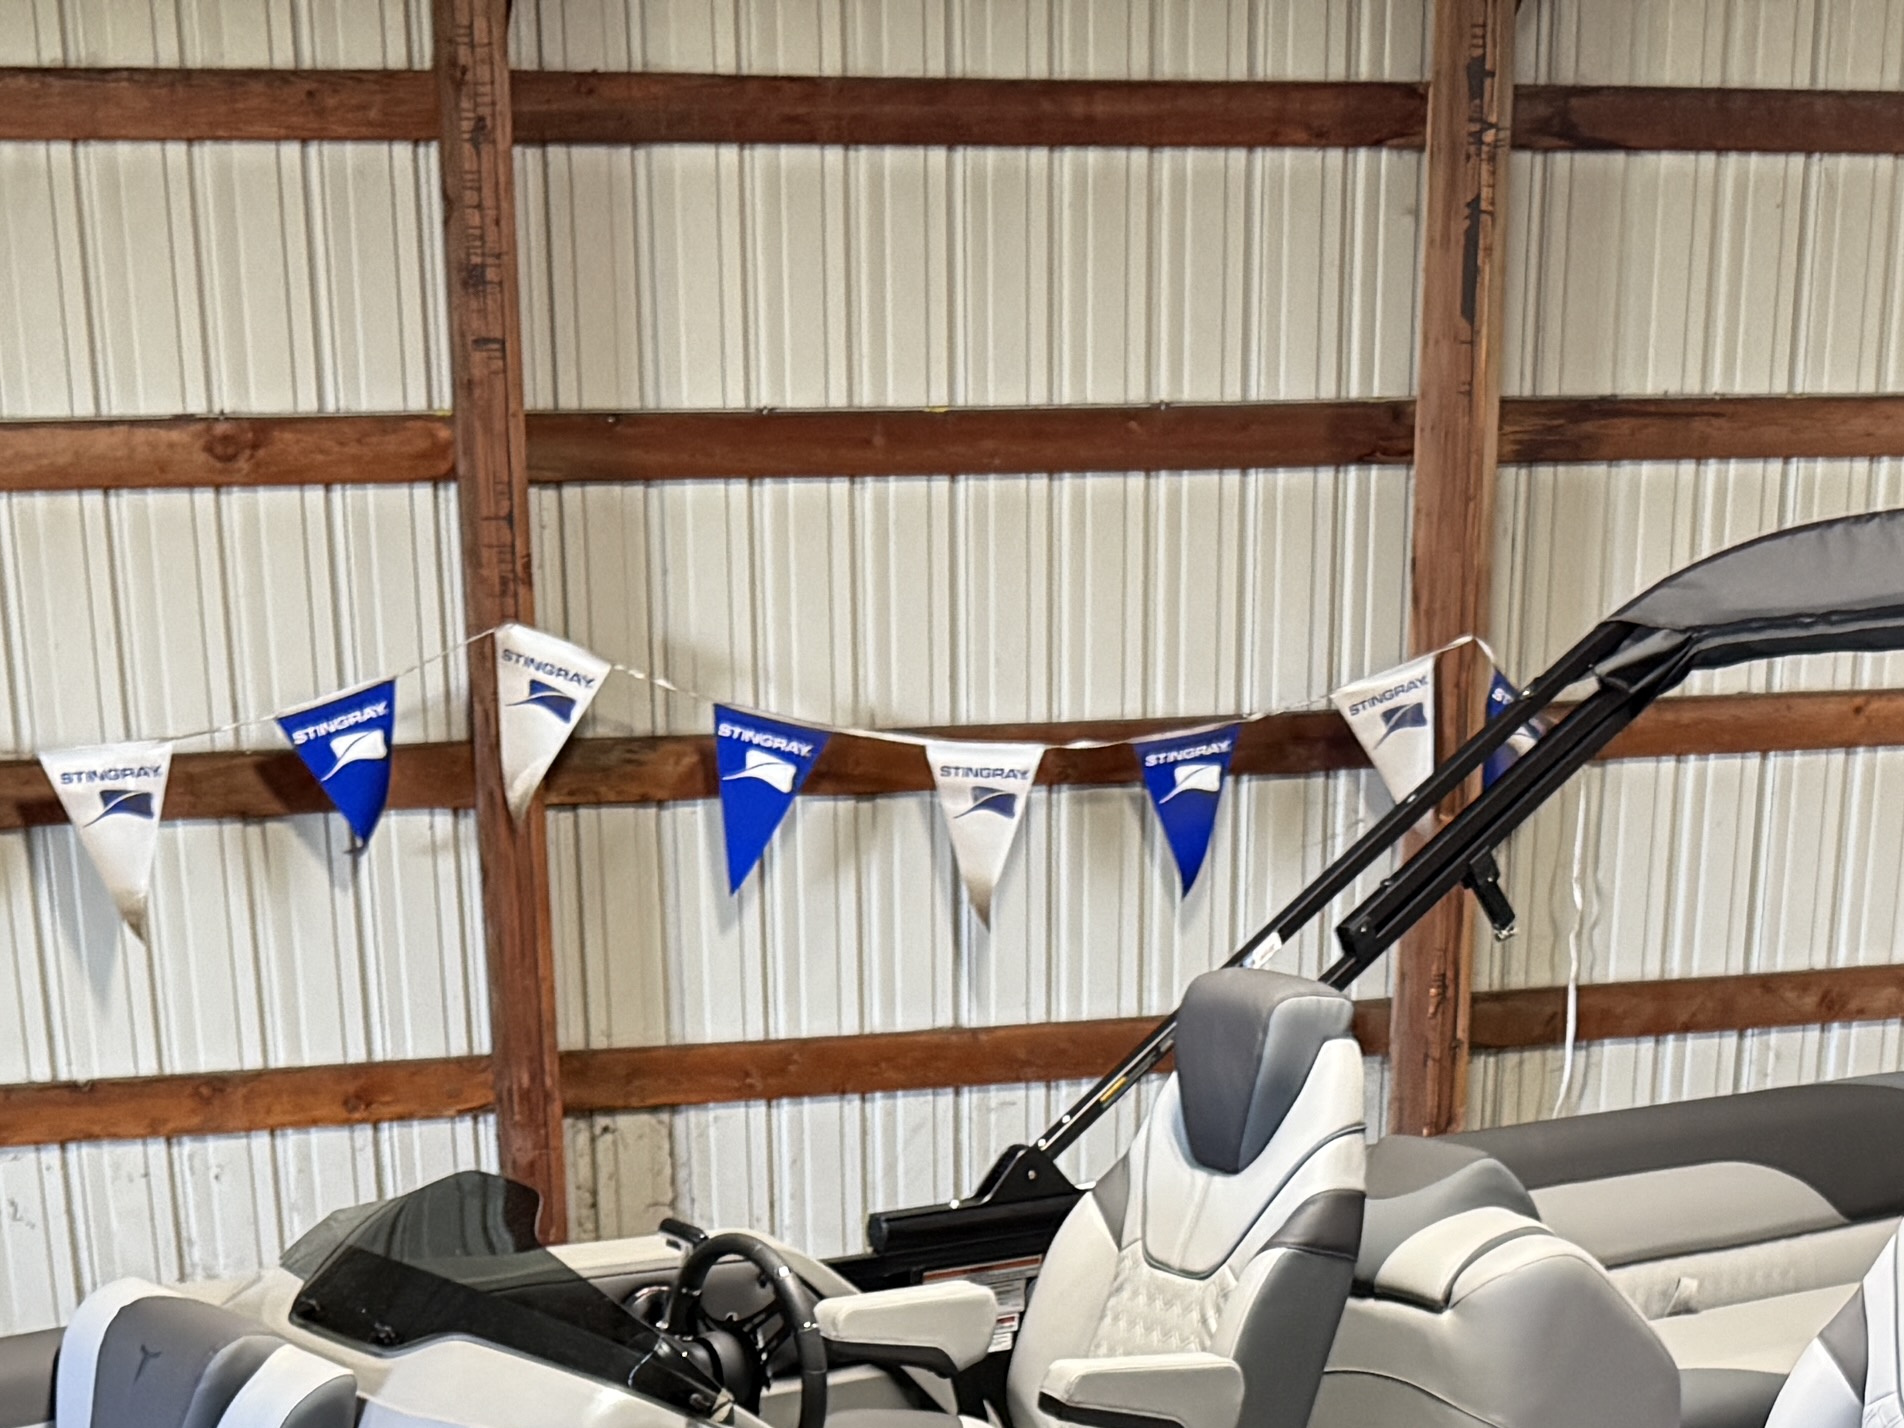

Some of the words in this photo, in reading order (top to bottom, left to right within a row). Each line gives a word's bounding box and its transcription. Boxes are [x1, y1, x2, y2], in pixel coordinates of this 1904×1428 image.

[500, 648, 595, 689] STINGRAY
[1348, 675, 1429, 717] STINGRAY
[292, 700, 388, 746] STINGRAY
[718, 722, 812, 758] STINGRAY
[1144, 739, 1231, 766] STINGRAY
[59, 763, 163, 785] STINGRAY
[939, 764, 1030, 782] STINGRAY
